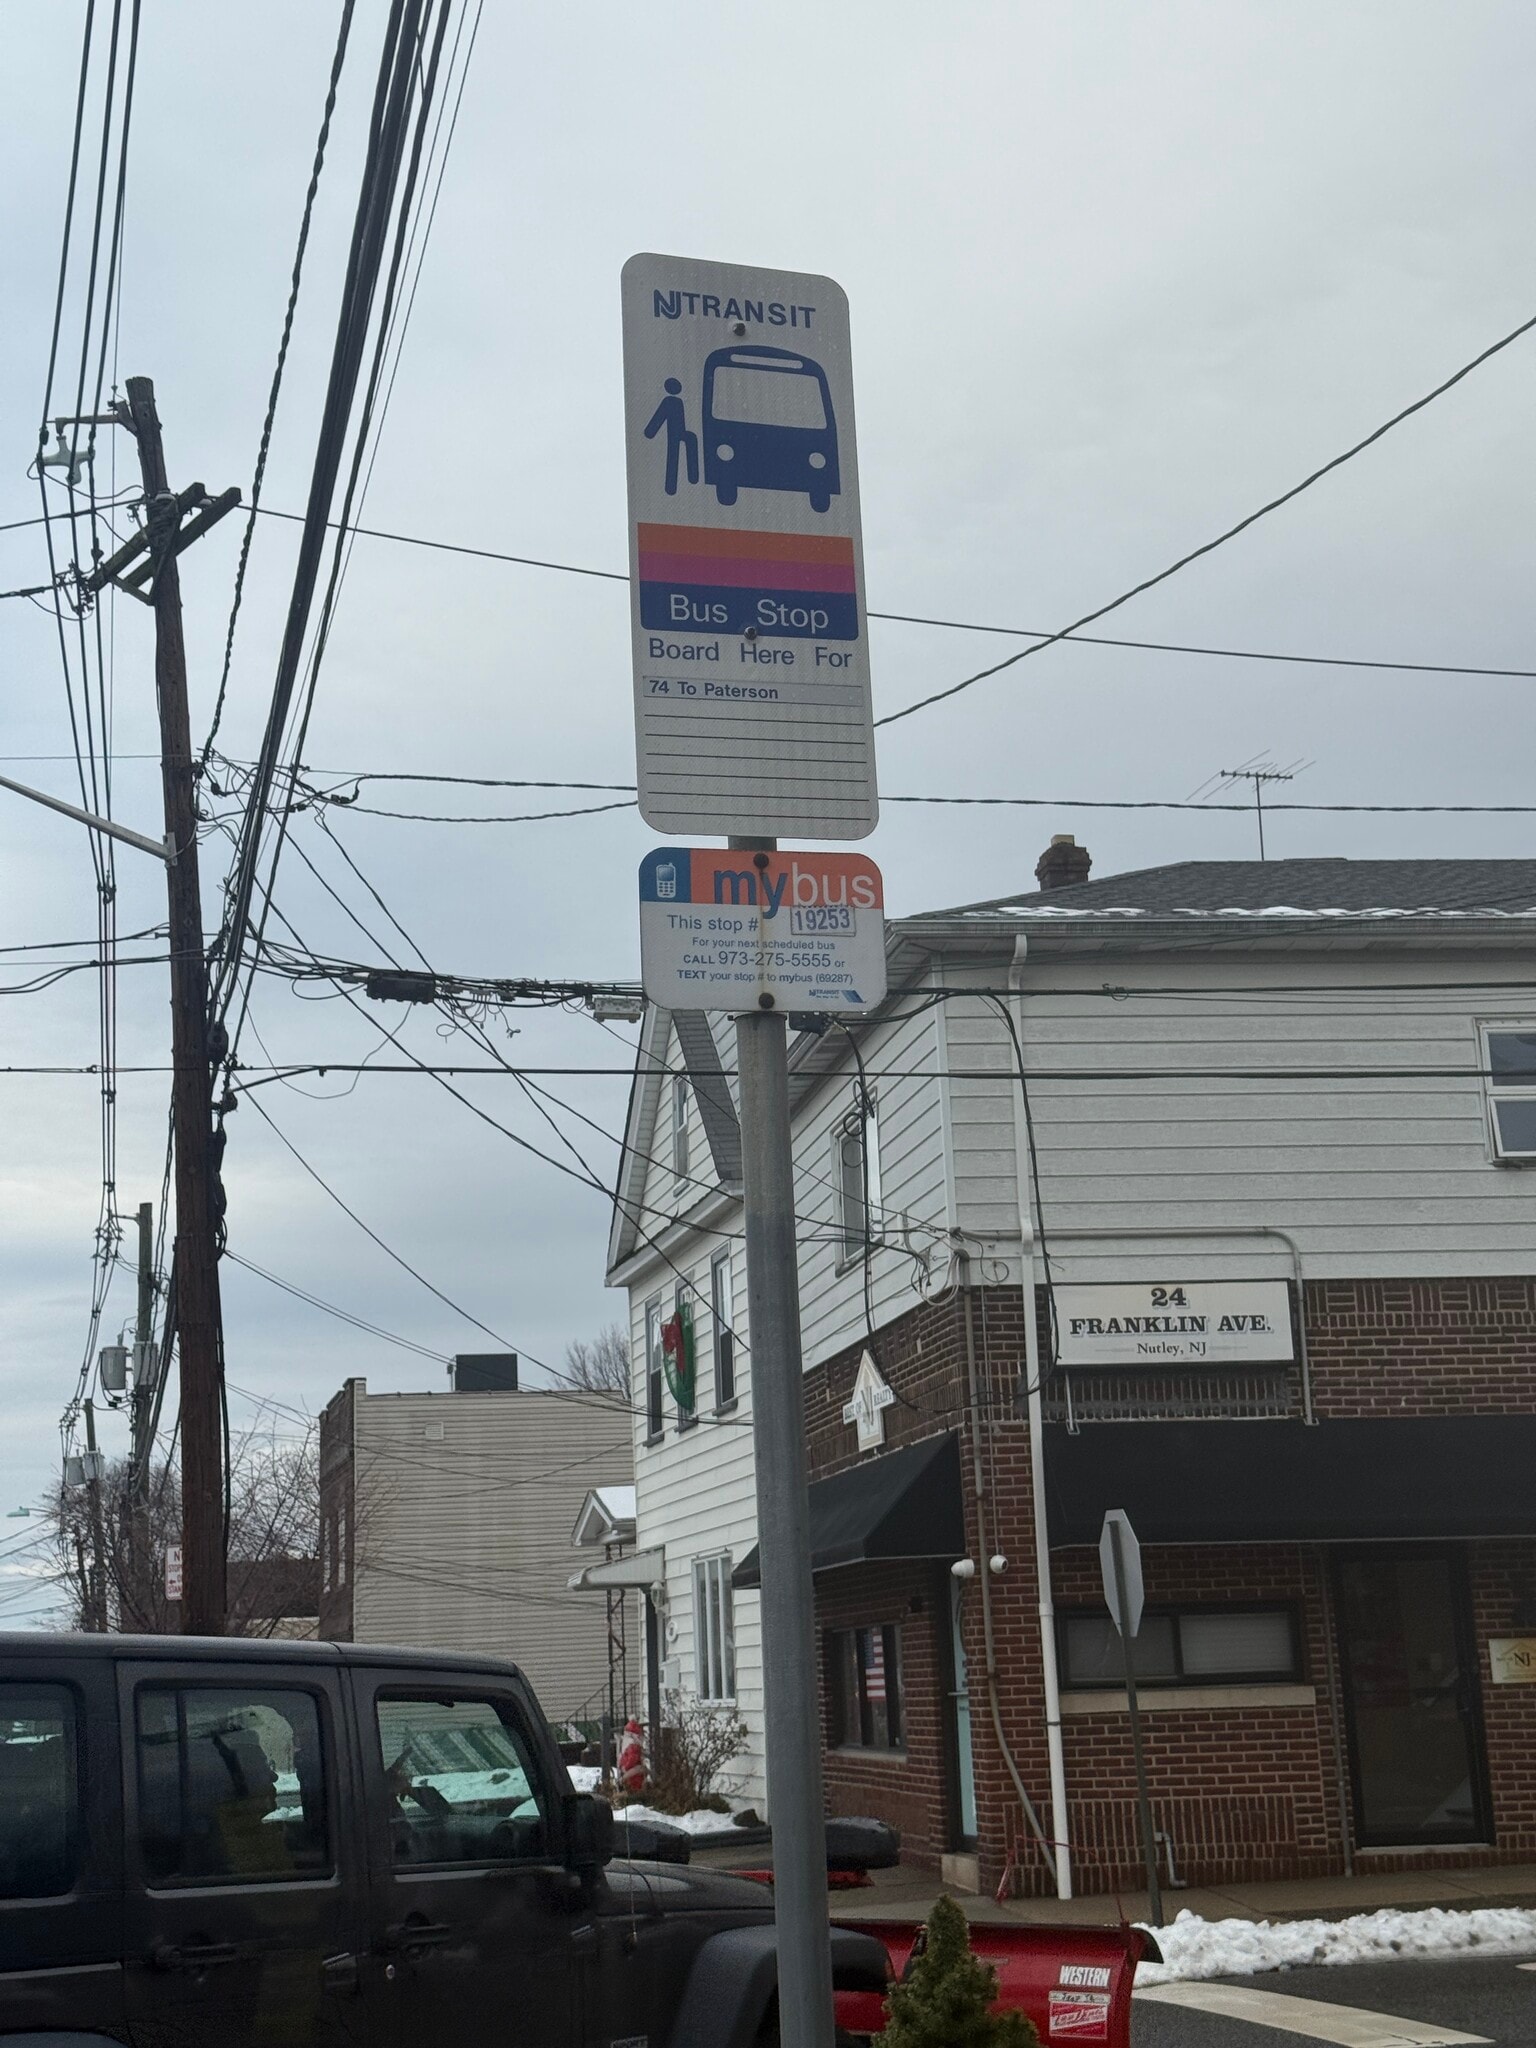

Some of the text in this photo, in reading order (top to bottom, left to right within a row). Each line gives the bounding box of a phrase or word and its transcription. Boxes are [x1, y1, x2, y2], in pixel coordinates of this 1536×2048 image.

[670, 594, 829, 635] Bus Stop
[649, 638, 853, 668] Board Here For
[649, 680, 779, 700] 74 To Paterson
[714, 862, 876, 920] mybus
[667, 907, 851, 933] This stop # 19253
[692, 937, 836, 950] For your next scheduled bus
[683, 951, 845, 968] CALL 973-275-5555 or
[677, 969, 706, 980] TEXT
[709, 972, 733, 982] your
[734, 972, 755, 983] stop
[767, 973, 776, 982] to
[779, 974, 813, 984] mybus
[815, 974, 853, 985] (69287)
[1151, 1287, 1187, 1307] 24
[1069, 1314, 1272, 1335] FRANKLIN AVE.
[1136, 1341, 1207, 1356] Nutley, NJ
[1059, 1965, 1111, 1987] WESTERN
